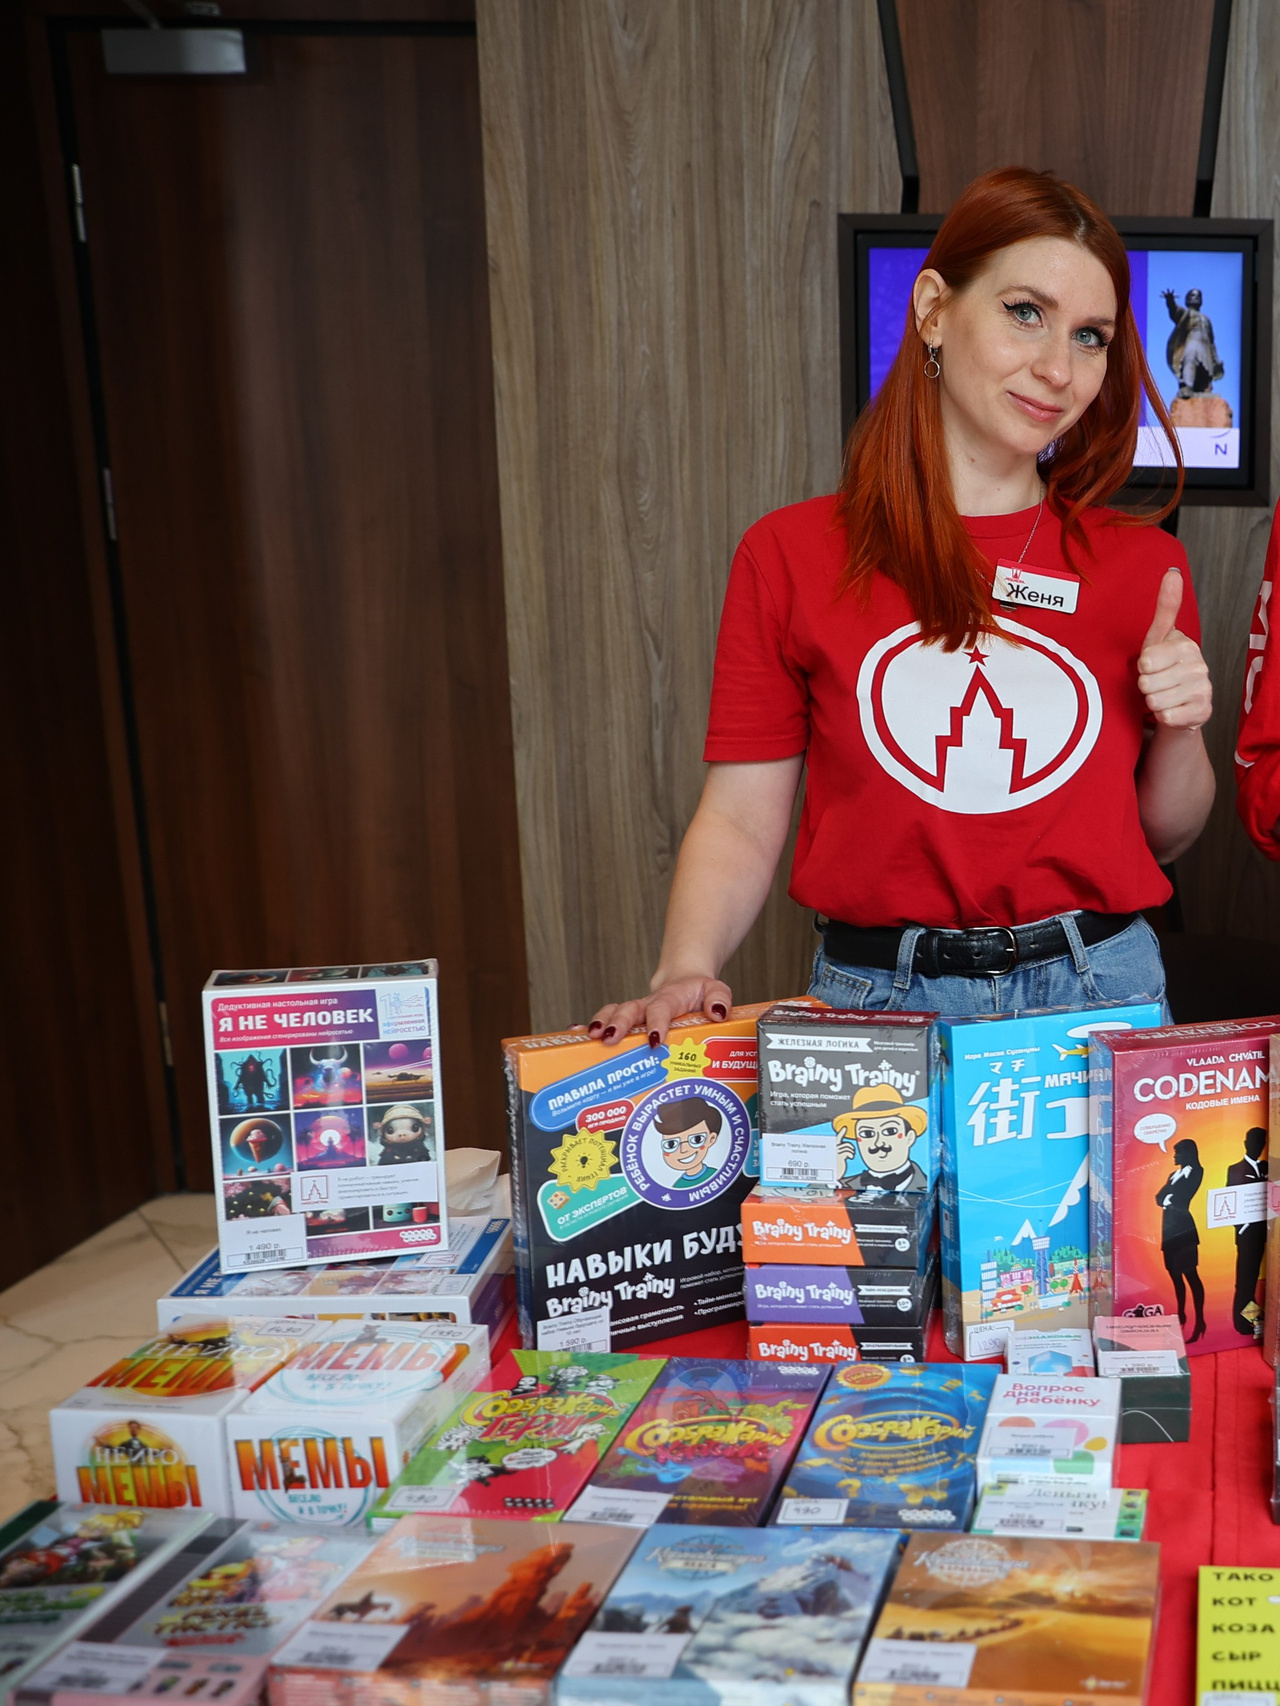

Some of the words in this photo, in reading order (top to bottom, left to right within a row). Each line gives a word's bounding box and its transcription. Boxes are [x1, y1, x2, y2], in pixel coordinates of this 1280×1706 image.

[1006, 582, 1064, 608] Женя
[217, 1000, 271, 1012] Дедуктивная
[272, 998, 318, 1009] настольная
[320, 997, 338, 1006] игра
[218, 1017, 233, 1032] Я
[239, 1014, 268, 1030] НЕ
[274, 1008, 374, 1028] ЧЕЛОВЕК
[232, 1033, 271, 1042] изображения
[272, 1031, 316, 1040] сгенерированы
[318, 1028, 353, 1037] нейросетью
[778, 1038, 823, 1047] ЖЕЛЕЗНАЯ
[826, 1039, 860, 1049] ЛОГИКА
[678, 1051, 697, 1061] 160
[712, 1060, 720, 1068] И
[1186, 1055, 1225, 1067] VLAADA
[1228, 1050, 1266, 1063] CHVÁTIL
[548, 1076, 604, 1110] ПРАВИЛА
[606, 1055, 660, 1084] ПРОСТЫ:
[767, 1056, 842, 1092] Brainy
[844, 1059, 919, 1097] Trainy
[1133, 1065, 1270, 1103] CODENAM
[694, 1084, 737, 1114] УМНЫМ
[770, 1091, 789, 1099] Игра,
[791, 1092, 819, 1100] которая
[1185, 1097, 1229, 1111] КОДОВЫЕ
[1230, 1094, 1261, 1105] ИМЕНА
[585, 1109, 605, 1122] 300
[606, 1106, 627, 1117] 000
[632, 1084, 691, 1131] ВЫРАСТЕТ
[732, 1115, 743, 1124] И
[626, 1134, 651, 1192] РЕБЁНОК
[688, 1127, 745, 1202] СЧАСТЛИВЫМ
[557, 1214, 571, 1225] ОТ
[572, 1186, 628, 1218] ЭКСПЕРТОВ
[752, 1218, 803, 1241] Brainy
[804, 1220, 852, 1244] Trainy
[256, 1242, 272, 1251] 490
[546, 1239, 672, 1288] НАВЫКИ
[546, 1286, 613, 1318] Brainy
[614, 1272, 676, 1300] Trainy
[755, 1281, 805, 1303] Brainy
[806, 1282, 854, 1305] Trainy
[639, 1304, 685, 1321] грамотность
[637, 1314, 684, 1331] выступления
[973, 1324, 995, 1334] ЦЕНА:
[758, 1339, 808, 1361] Brainy
[809, 1339, 857, 1361] Trainy
[283, 1341, 470, 1383] МЕМЫ
[1011, 1383, 1085, 1393] Вопрос
[1016, 1395, 1101, 1406] ребёнку
[234, 1437, 391, 1491] МЕМЫ
[76, 1464, 203, 1508] МЕМЫ
[1213, 1572, 1274, 1582] ТАКО
[1212, 1597, 1258, 1607] КОТ
[1212, 1624, 1275, 1634] КОЗА
[1212, 1651, 1262, 1661] СЫР
